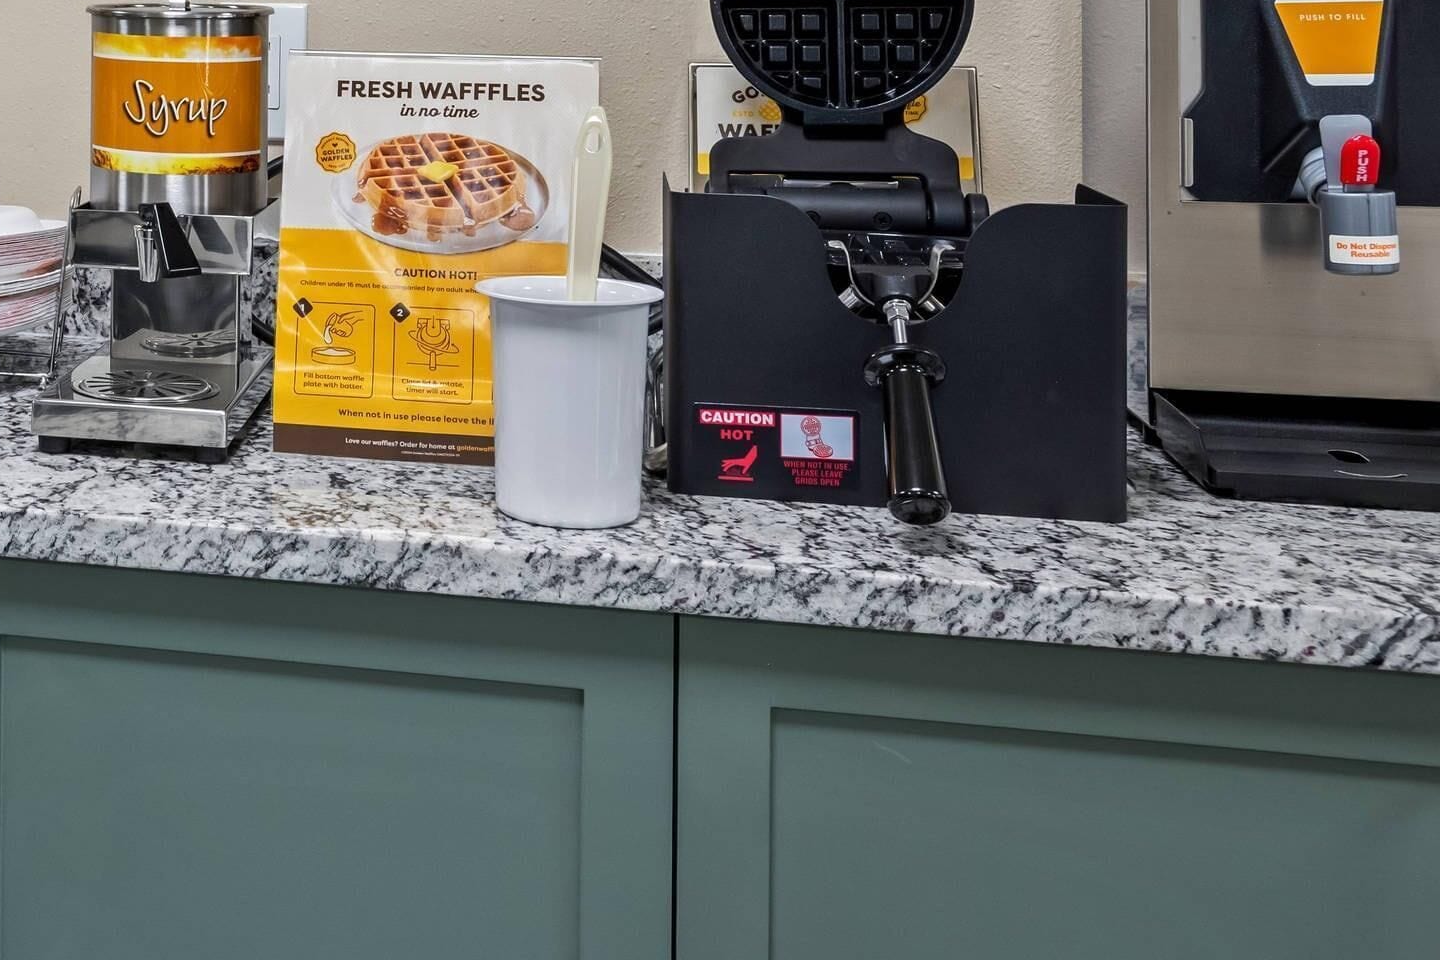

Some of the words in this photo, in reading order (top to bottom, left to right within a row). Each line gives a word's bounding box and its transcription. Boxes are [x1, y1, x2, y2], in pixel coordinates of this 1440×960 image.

[1346, 13, 1366, 21] FILL
[336, 80, 413, 99] FRESH
[418, 82, 546, 102] WAFFFLES
[732, 86, 764, 104] GO
[124, 78, 229, 137] Syrup
[400, 103, 417, 117] in
[418, 107, 441, 118] no
[443, 104, 480, 119] time
[322, 148, 350, 156] GOLDEN
[320, 154, 352, 162] WAFFLES
[1356, 149, 1368, 182] PUSH
[1336, 242, 1348, 250] Do
[1350, 250, 1390, 258] Reusable
[394, 268, 446, 279] CAUTION
[449, 271, 478, 280] HOT!
[328, 280, 346, 288] under
[300, 303, 306, 312] 1
[396, 309, 403, 317] 2
[304, 380, 322, 388] plate
[406, 386, 424, 394] timer
[338, 408, 364, 418] When
[365, 411, 381, 419] not
[383, 412, 391, 420] in
[411, 414, 442, 424] please
[444, 415, 469, 424] leave
[471, 417, 486, 426] the
[700, 411, 774, 425] CAUTION
[720, 429, 754, 441] HOT
[345, 437, 360, 445] Love
[372, 439, 398, 448] waffles?
[400, 441, 418, 449] Order
[428, 442, 447, 450] home
[783, 460, 806, 468] WHEN
[824, 462, 832, 470] IN
[792, 468, 818, 477] PLEASE
[820, 470, 843, 478] LEAVE
[795, 477, 818, 485] GRIDS
[820, 478, 840, 487] OPEN
